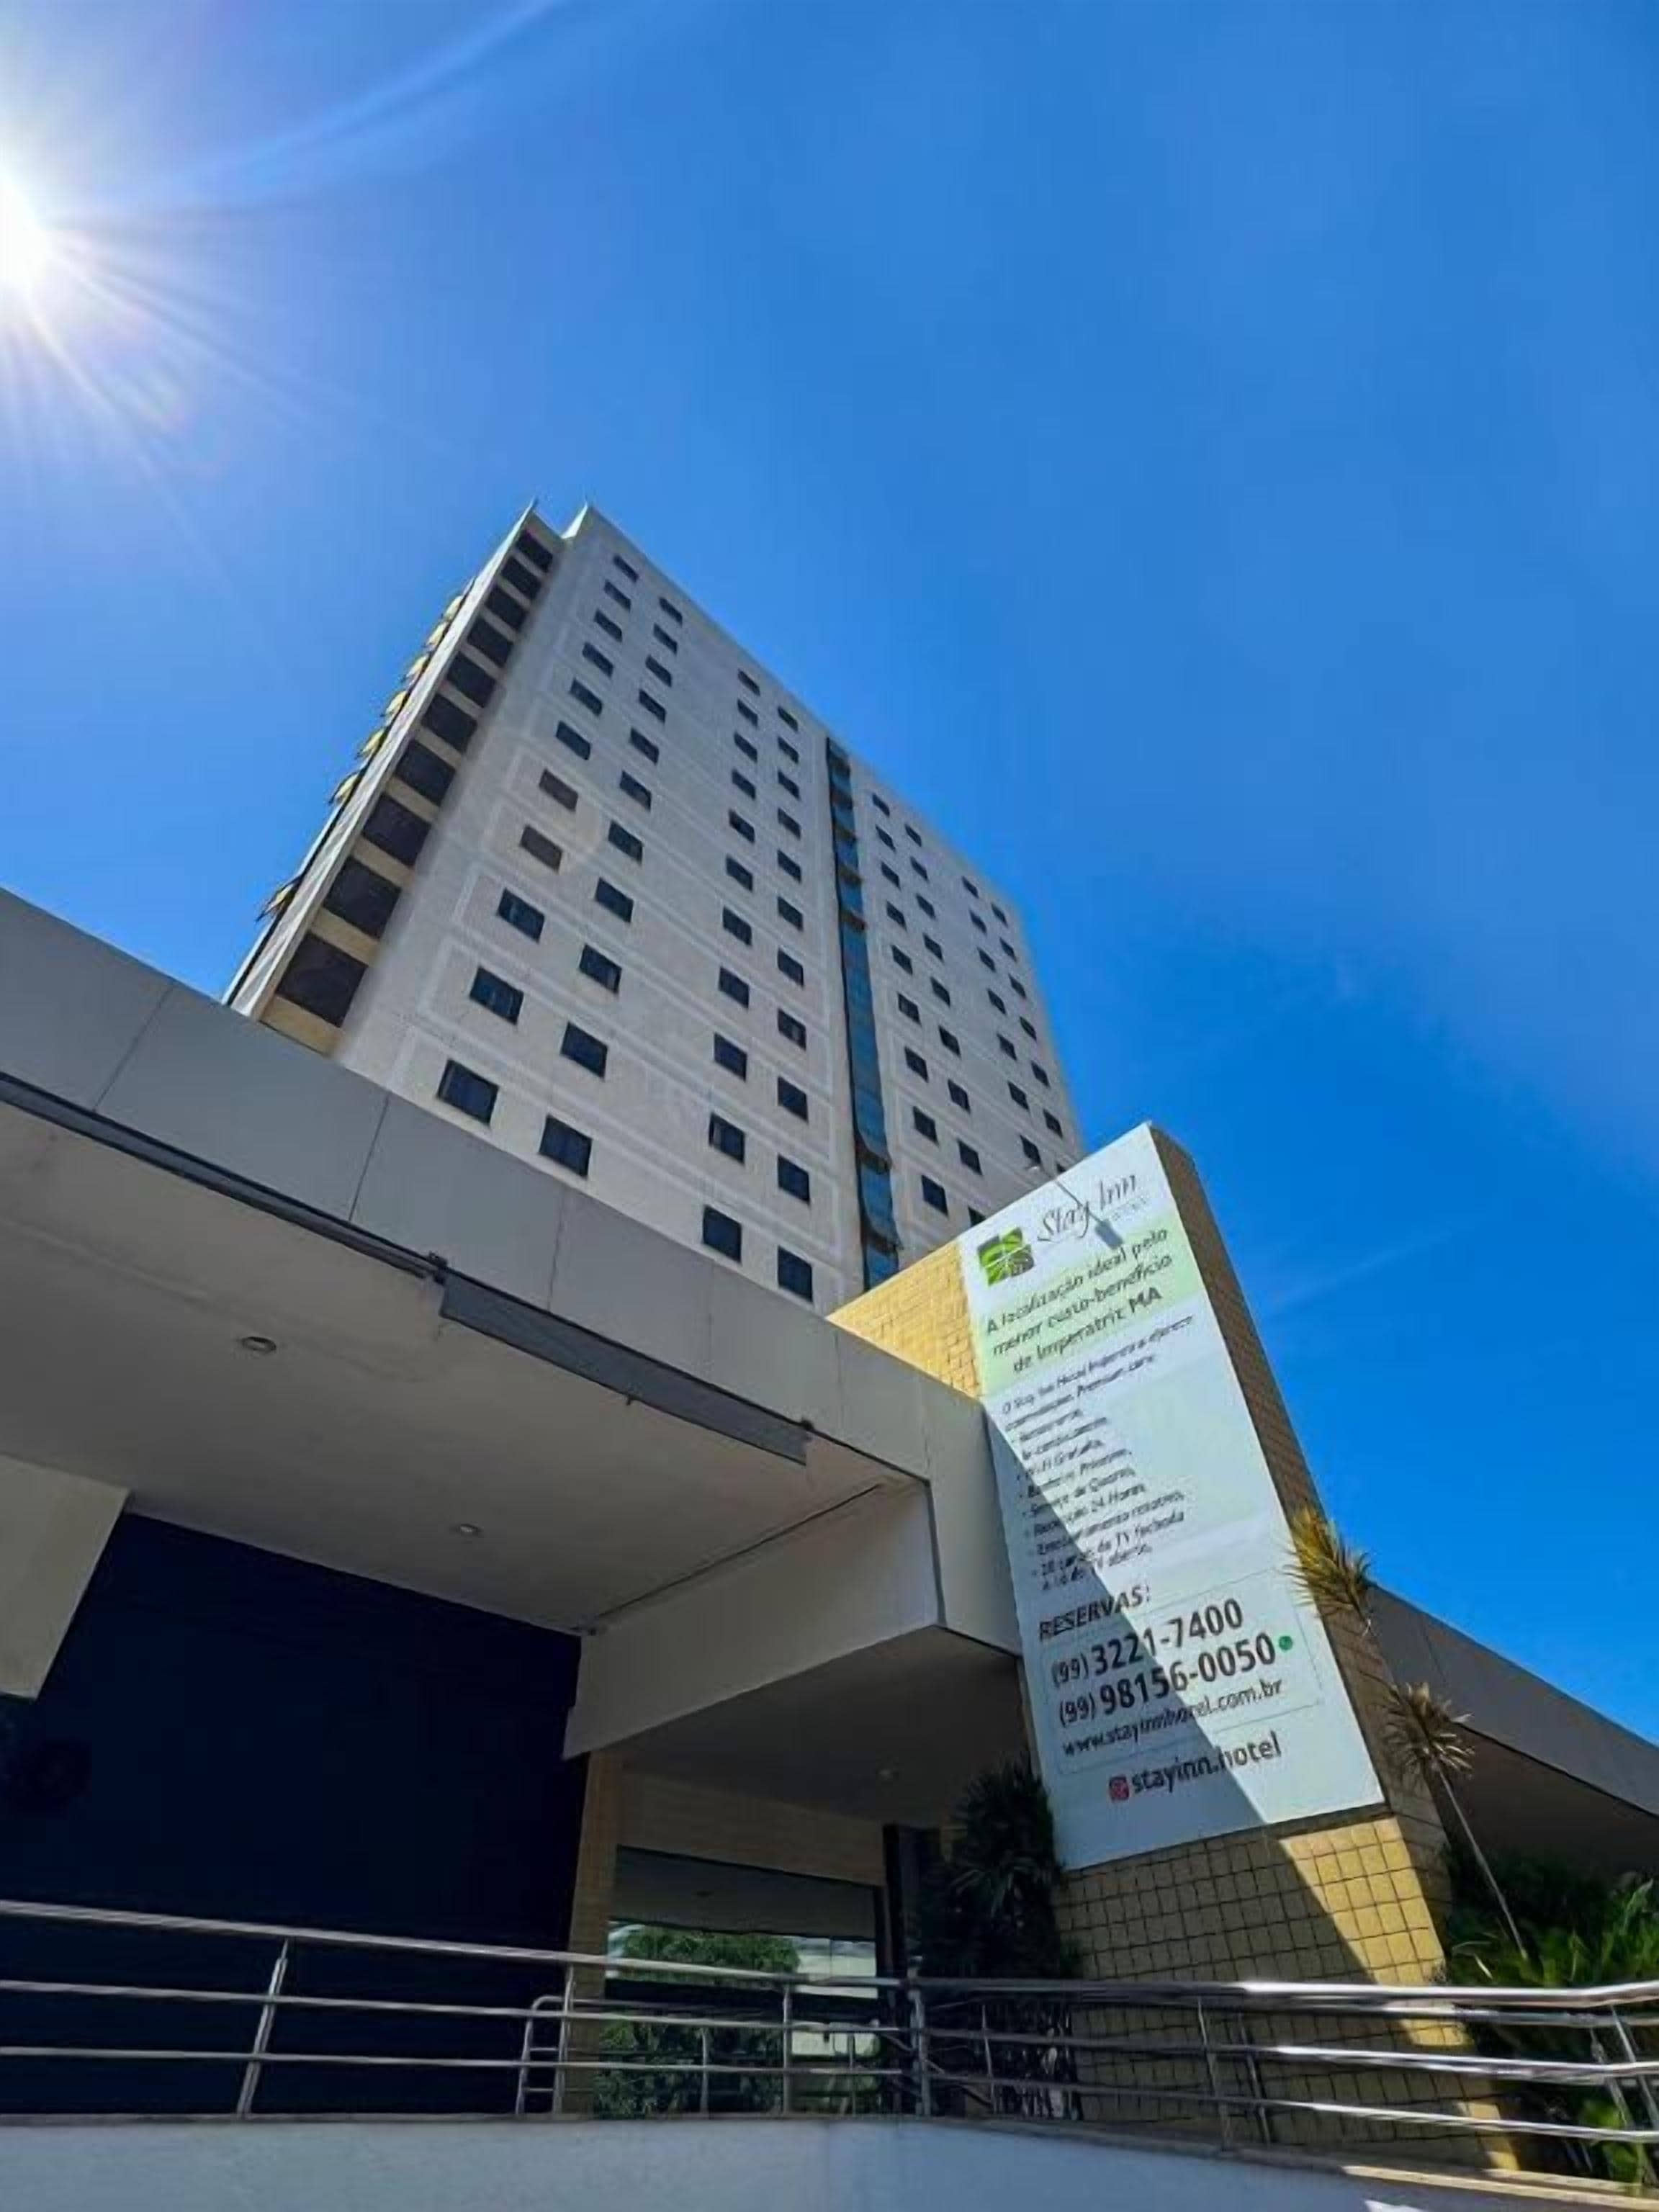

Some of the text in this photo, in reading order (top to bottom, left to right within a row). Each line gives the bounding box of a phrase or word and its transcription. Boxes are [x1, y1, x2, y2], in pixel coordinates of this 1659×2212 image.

[1037, 1200, 1090, 1242] Stay
[1099, 1174, 1136, 1211] Inn
[986, 1318, 999, 1335] A
[1088, 1246, 1127, 1280] ideal
[1131, 1229, 1168, 1259] pelo
[1013, 1355, 1032, 1373] de
[1128, 1287, 1163, 1314] MA
[1039, 1584, 1150, 1642] RESERVAS:
[1051, 1598, 1243, 1689] (99) 3221-7400
[1059, 1632, 1276, 1729] (99) 98156-0050
[1131, 1730, 1282, 1794] stayinn.hotel
